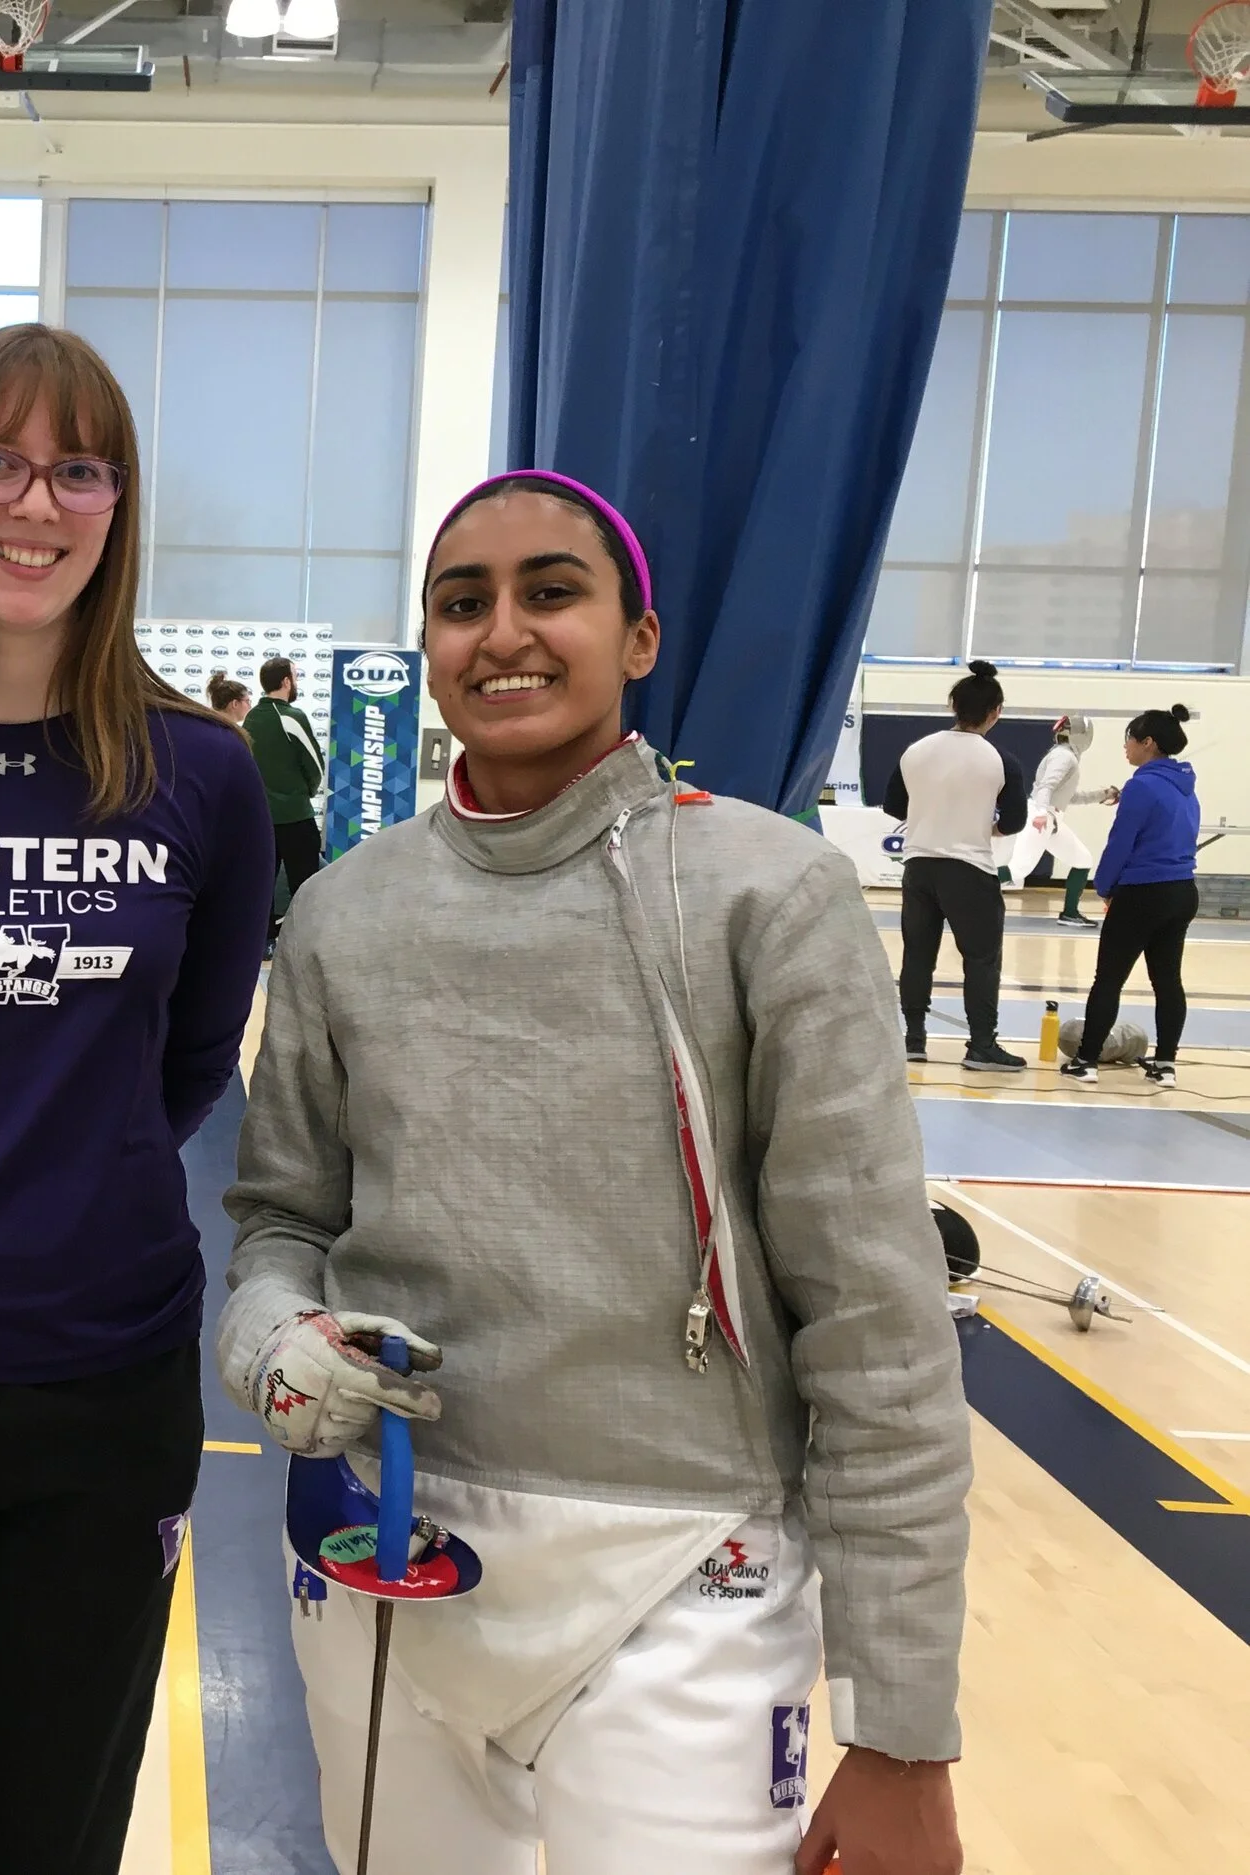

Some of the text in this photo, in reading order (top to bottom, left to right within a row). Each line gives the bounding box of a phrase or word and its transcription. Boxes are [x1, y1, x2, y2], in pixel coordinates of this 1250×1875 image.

[347, 668, 405, 681] OUA
[73, 956, 114, 970] 1913
[718, 1586, 743, 1599] 350
